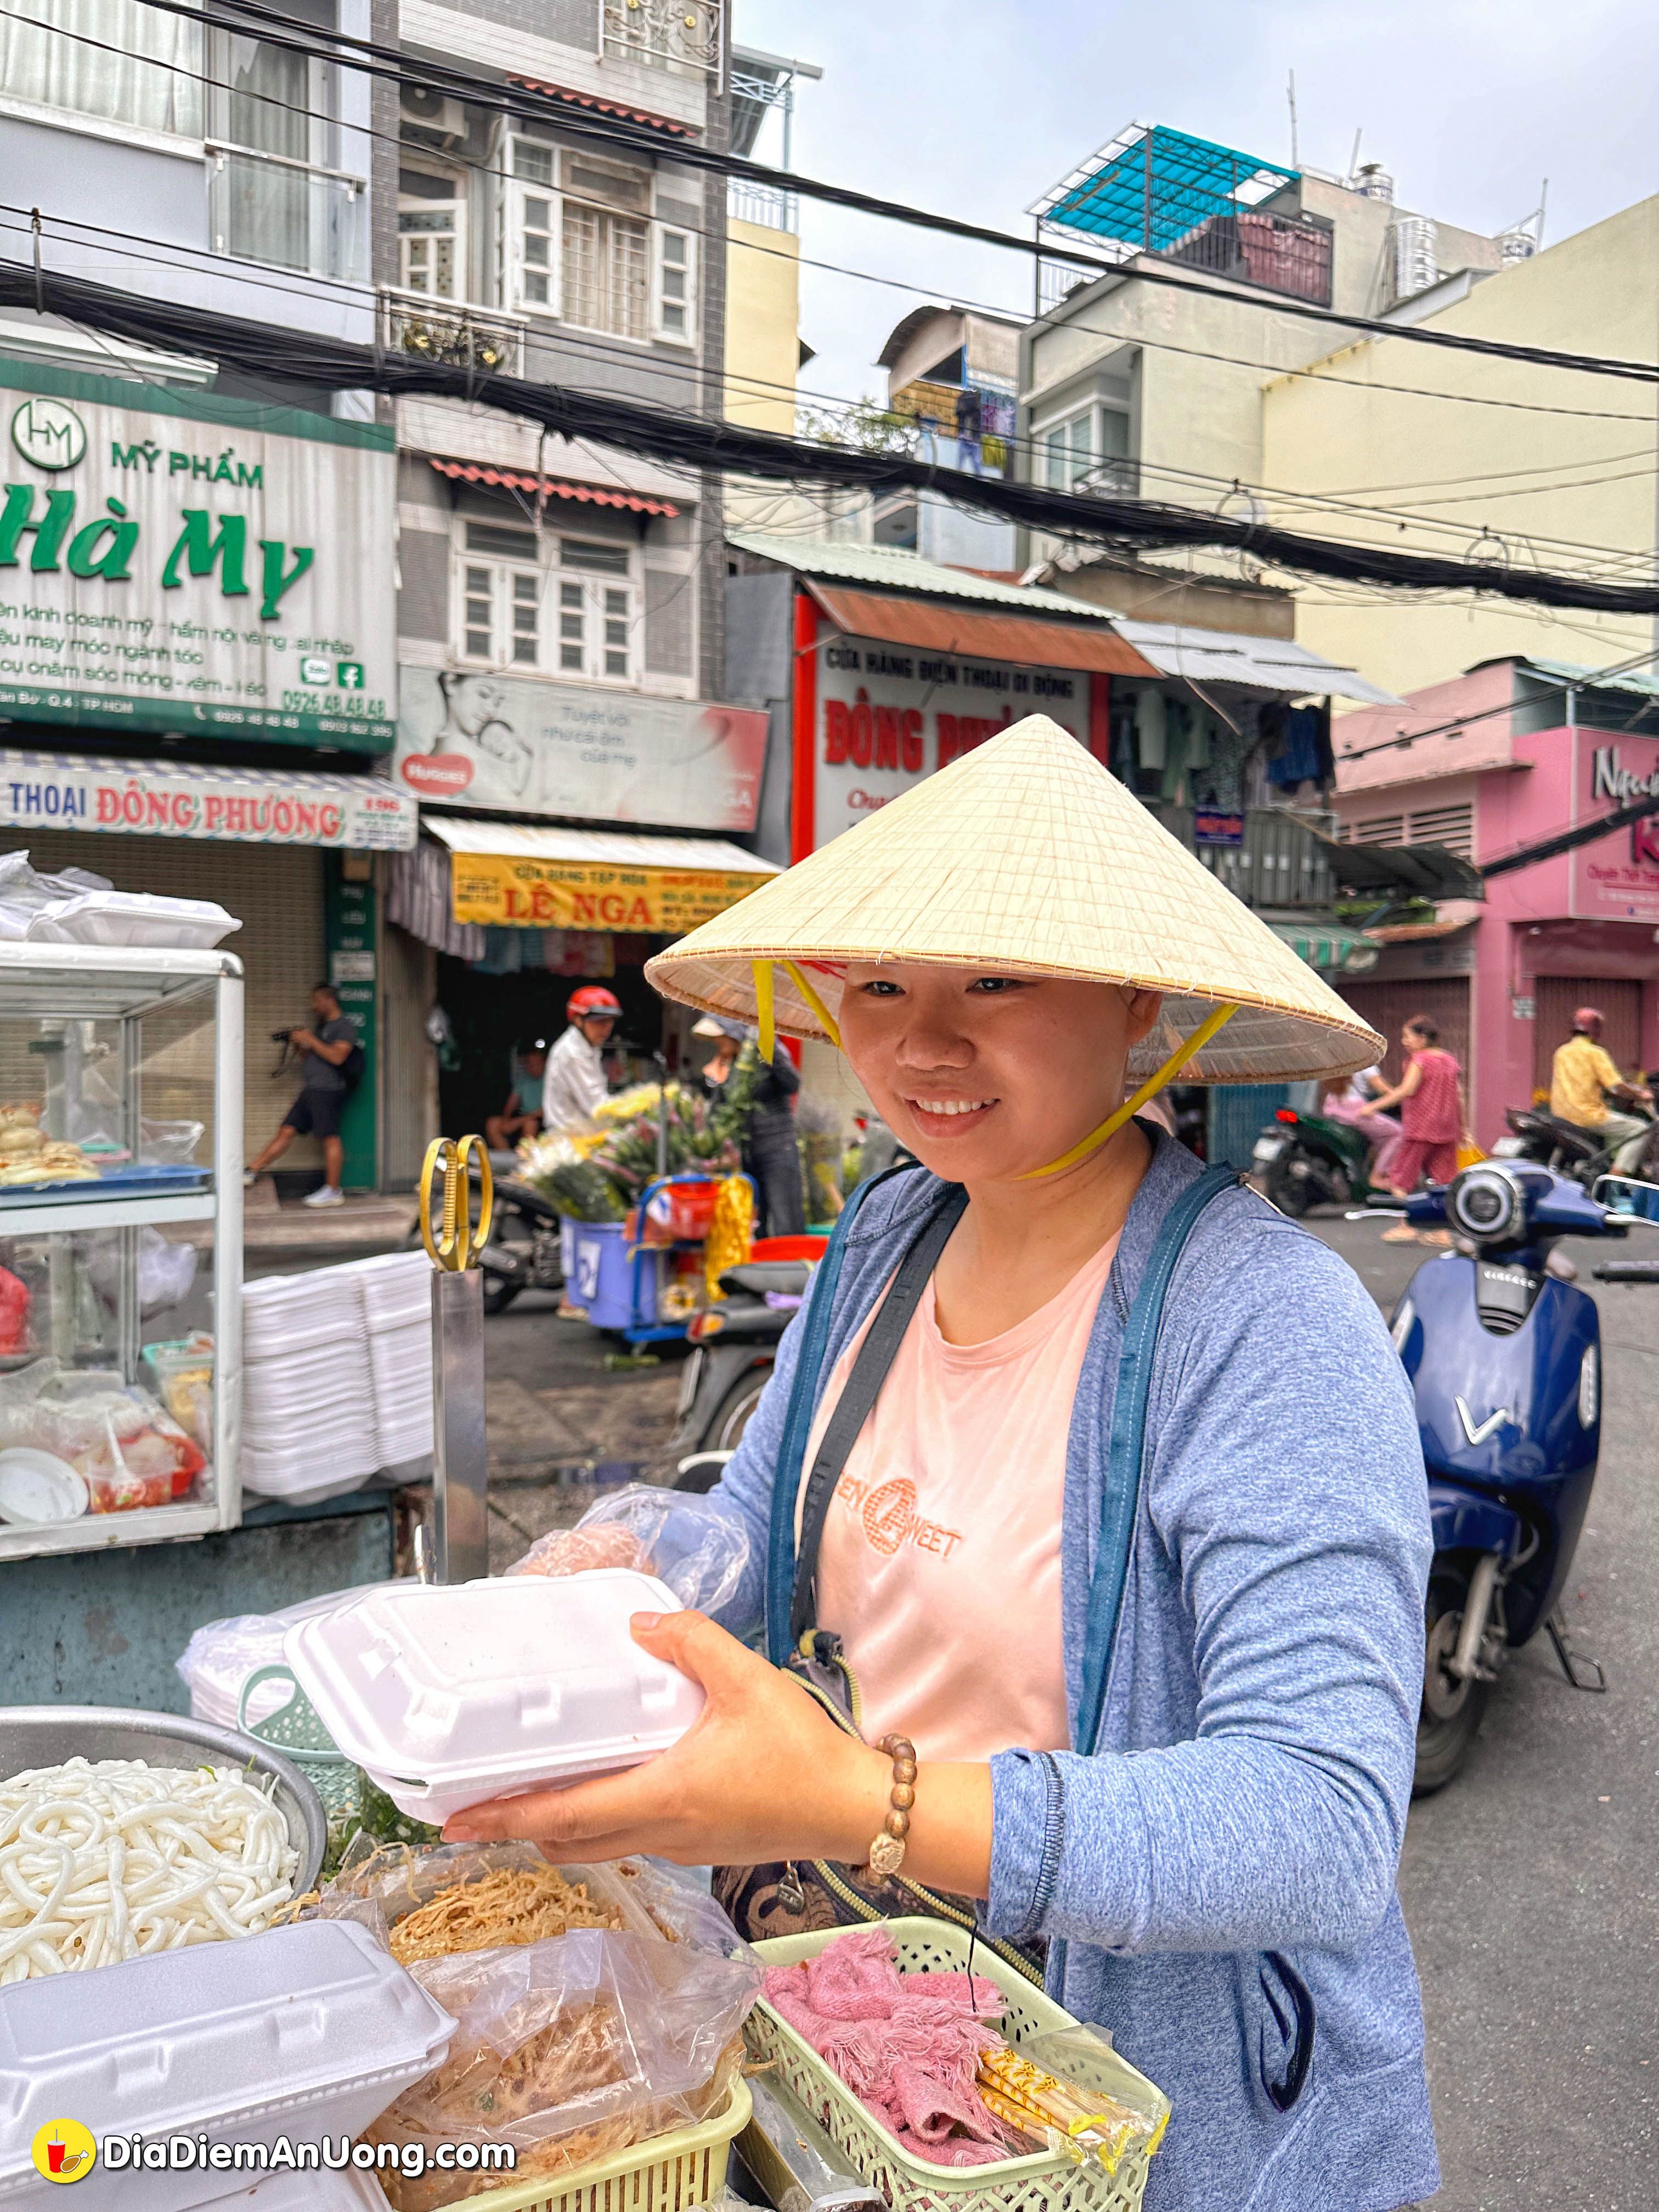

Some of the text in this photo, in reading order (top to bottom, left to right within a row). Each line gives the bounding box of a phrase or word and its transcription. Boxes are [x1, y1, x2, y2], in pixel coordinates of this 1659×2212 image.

[111, 439, 263, 489] MỸ PHẨM
[0, 484, 314, 620] Hà My
[9, 782, 86, 823] THOẠI
[204, 794, 342, 838] PHƯƠNG
[503, 883, 655, 926] LÊ NGA
